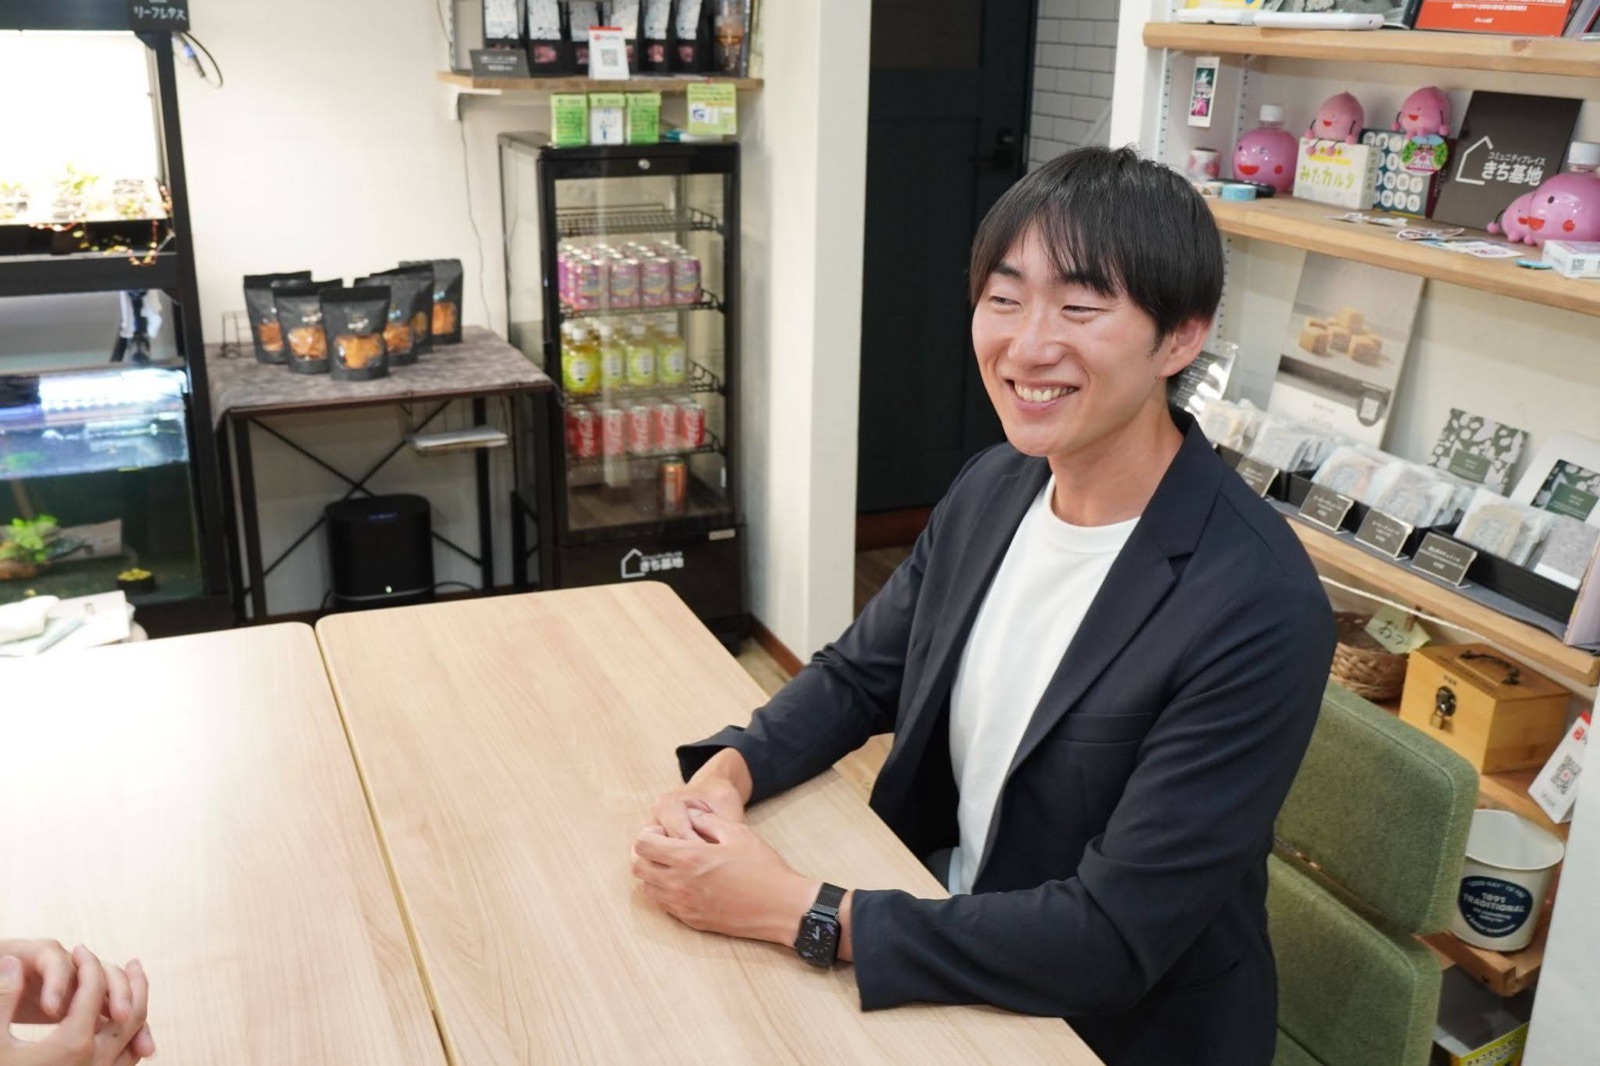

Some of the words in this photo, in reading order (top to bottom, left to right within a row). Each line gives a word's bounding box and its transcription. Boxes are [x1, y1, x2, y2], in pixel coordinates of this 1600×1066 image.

[133, 6, 187, 20] リーフレタス
[1481, 160, 1544, 186] きち基地
[1462, 893, 1525, 912] TRADITIONAL
